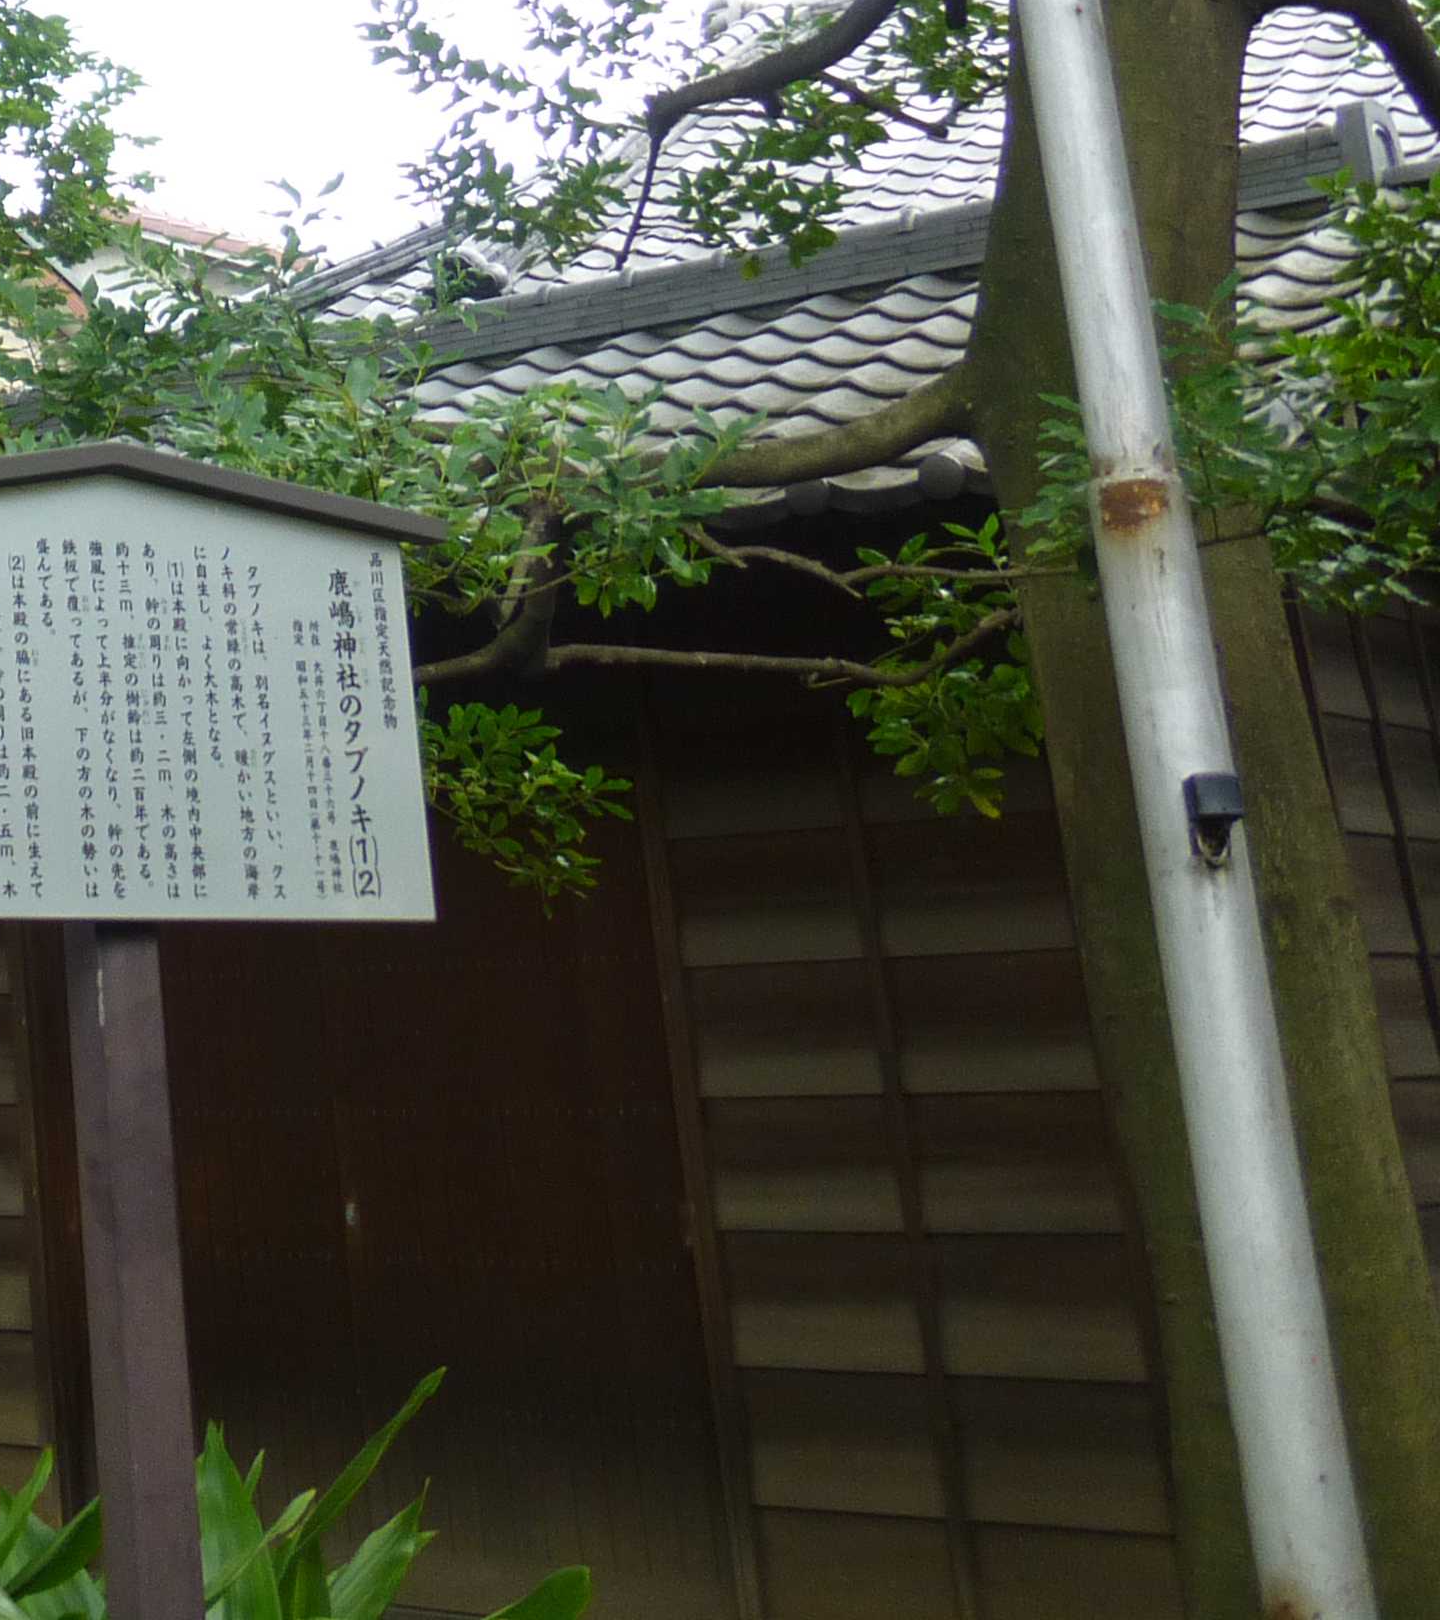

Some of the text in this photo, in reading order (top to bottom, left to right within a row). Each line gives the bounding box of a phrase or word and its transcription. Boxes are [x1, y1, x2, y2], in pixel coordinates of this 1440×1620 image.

[369, 553, 397, 729] 品川区指定天然記念物
